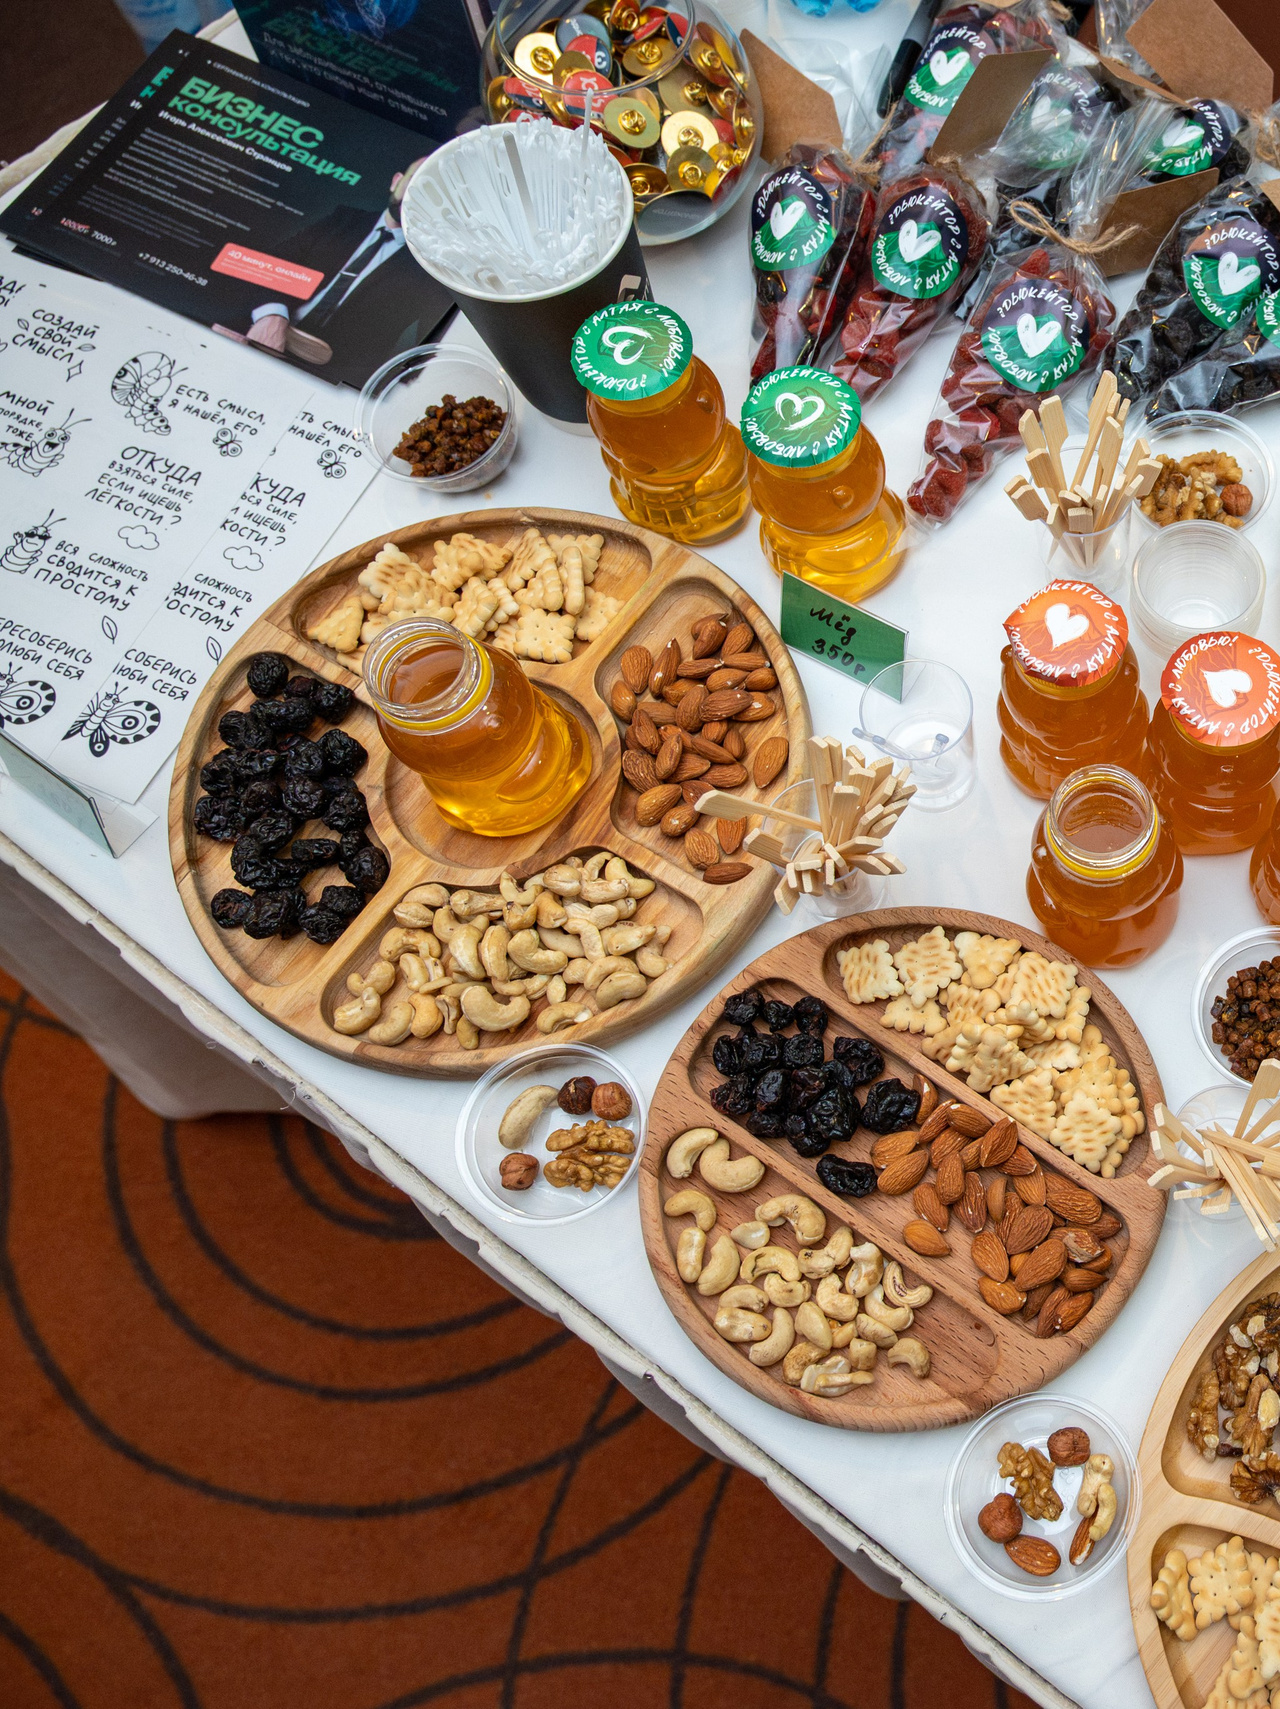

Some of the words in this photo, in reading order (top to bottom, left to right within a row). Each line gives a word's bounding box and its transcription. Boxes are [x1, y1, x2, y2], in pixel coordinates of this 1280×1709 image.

[179, 76, 324, 149] БИЗНЕС
[158, 110, 187, 127] Игорь
[187, 122, 245, 152] Алексеевич
[245, 147, 293, 173] Странцов
[816, 203, 829, 214] С
[802, 213, 830, 256] АЛТАЯ
[950, 238, 962, 249] С
[790, 248, 798, 261] С
[925, 249, 958, 289] АЛТАЯ
[913, 278, 922, 290] С
[1269, 273, 1278, 283] С
[32, 308, 100, 339] СОЗДАЙ
[582, 325, 591, 335] С
[592, 302, 644, 327] АЛТАЯ
[1071, 324, 1083, 334] С
[1227, 310, 1237, 322] С
[12, 333, 74, 363] СМЫСЛ
[33, 326, 78, 348] СВОЙ
[1053, 335, 1083, 380] АЛТАЯ
[1041, 371, 1049, 383] С
[0, 390, 54, 416] МНОЙ
[168, 399, 179, 409] Я
[184, 404, 226, 431] НАШЁЛ
[234, 421, 258, 436] ЕГО
[175, 384, 209, 403] ЕСТЬ
[218, 398, 266, 426] СМЫСЛ,
[5, 425, 34, 442] ТОЖЕ
[825, 401, 853, 448] АЛТАЯ
[288, 425, 331, 448] НАШЁЛ
[338, 443, 362, 459] ЕГО
[812, 441, 820, 455] С
[108, 460, 157, 487] ВЗЯТЬСЯ
[161, 480, 194, 503] СИЛЕ,
[120, 446, 203, 487] ОТКУДА
[98, 473, 134, 494] ЕСЛИ
[138, 489, 182, 513] ИЩЕШЬ
[249, 475, 307, 507] КУДА
[243, 509, 286, 534] ИЩЕШЬ
[266, 502, 298, 525] СИЛЕ,
[219, 518, 269, 547] КОСТИ
[47, 553, 122, 590] СВОДИТСЯ
[126, 583, 139, 597] К
[55, 539, 80, 556] ВСЯ
[89, 552, 149, 583] СЛОЖНОСТЬ
[34, 568, 130, 612] ПРОСТОМУ
[173, 582, 226, 610] ОДИТСЯ
[230, 605, 243, 618] К
[194, 573, 253, 603] СЛОЖНОСТЬ
[165, 596, 235, 632] ОСТОМУ
[809, 606, 857, 646] Мёд
[1104, 612, 1119, 622] С
[0, 617, 92, 665] ЕРЕСОБЕРИСЬ
[1086, 623, 1120, 673] АЛТАЯ
[0, 638, 43, 665] ОЛЮБИ
[47, 658, 85, 681] СЕБЯ
[124, 648, 197, 685] СОБЕРИСЬ
[1071, 663, 1081, 679] С
[152, 679, 189, 702] СЕБЯ
[1168, 683, 1182, 692] С
[1171, 697, 1222, 735] АЛТАЯ
[1224, 722, 1235, 737] С
